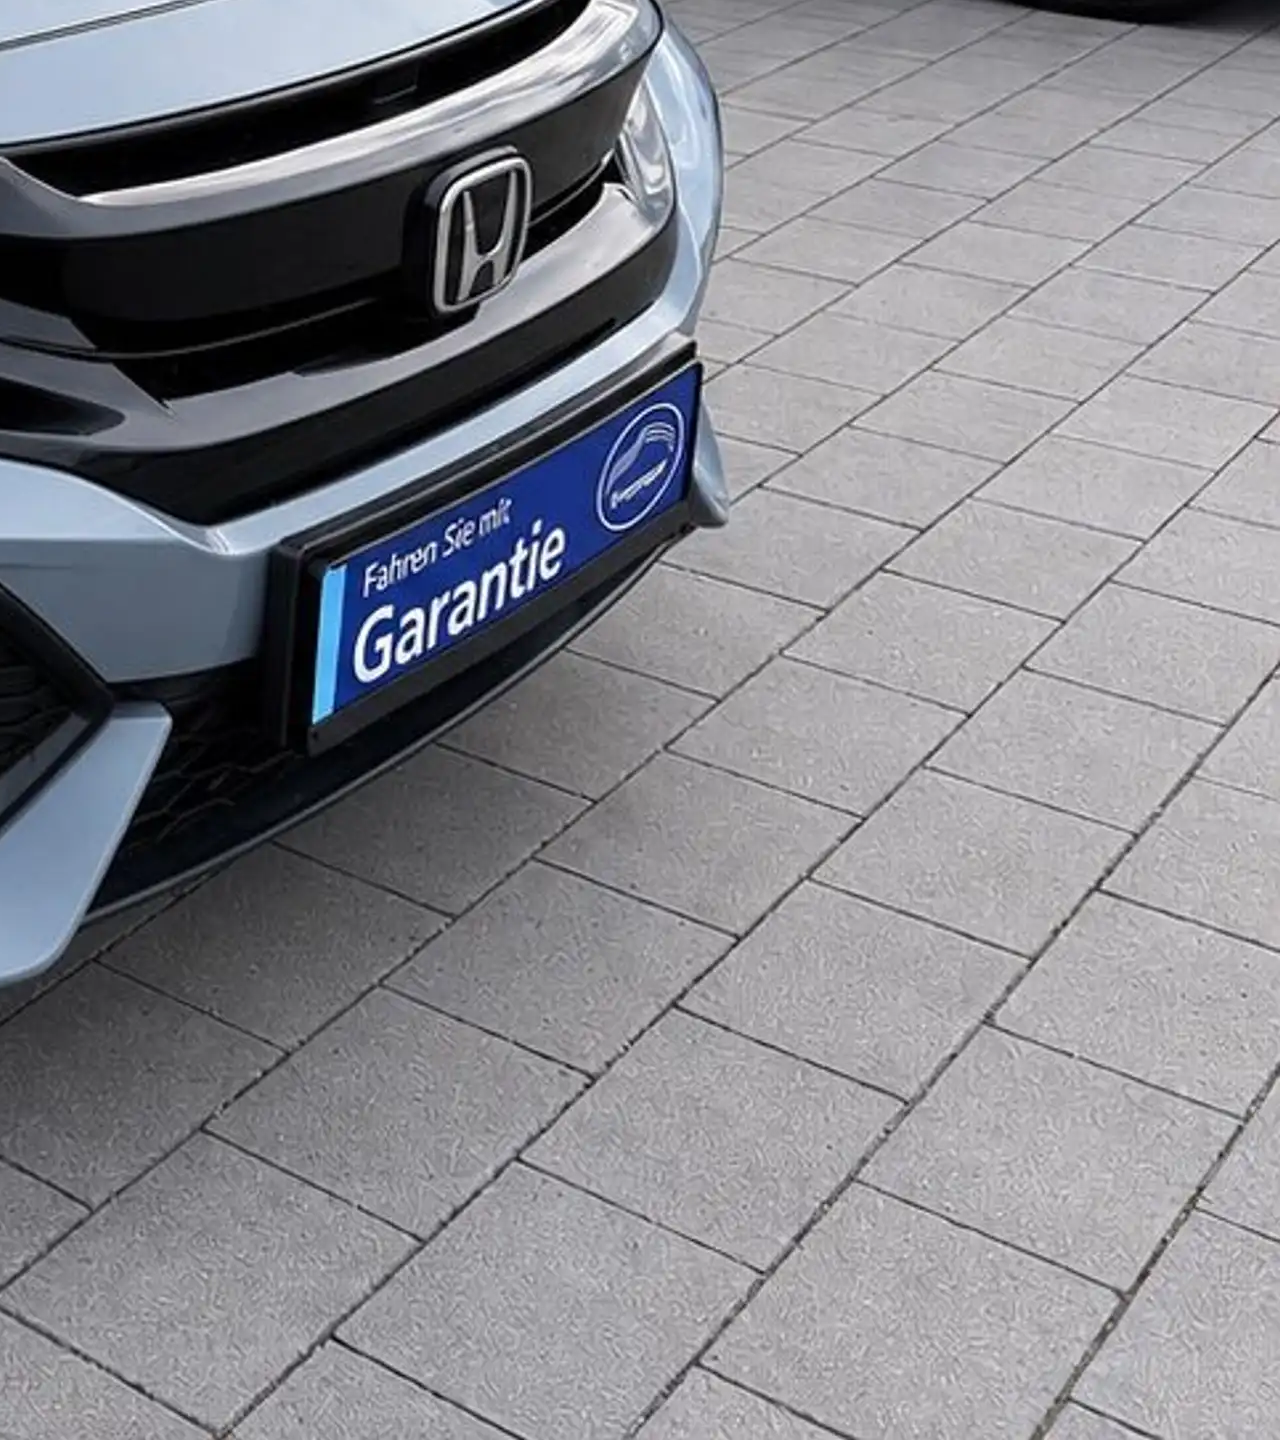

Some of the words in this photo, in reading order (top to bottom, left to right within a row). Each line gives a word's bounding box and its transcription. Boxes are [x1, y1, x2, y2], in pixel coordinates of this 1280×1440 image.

[353, 518, 567, 684] Garantie
[362, 540, 438, 598] Fahren
[442, 516, 476, 558] Sie
[478, 497, 512, 538] mit
